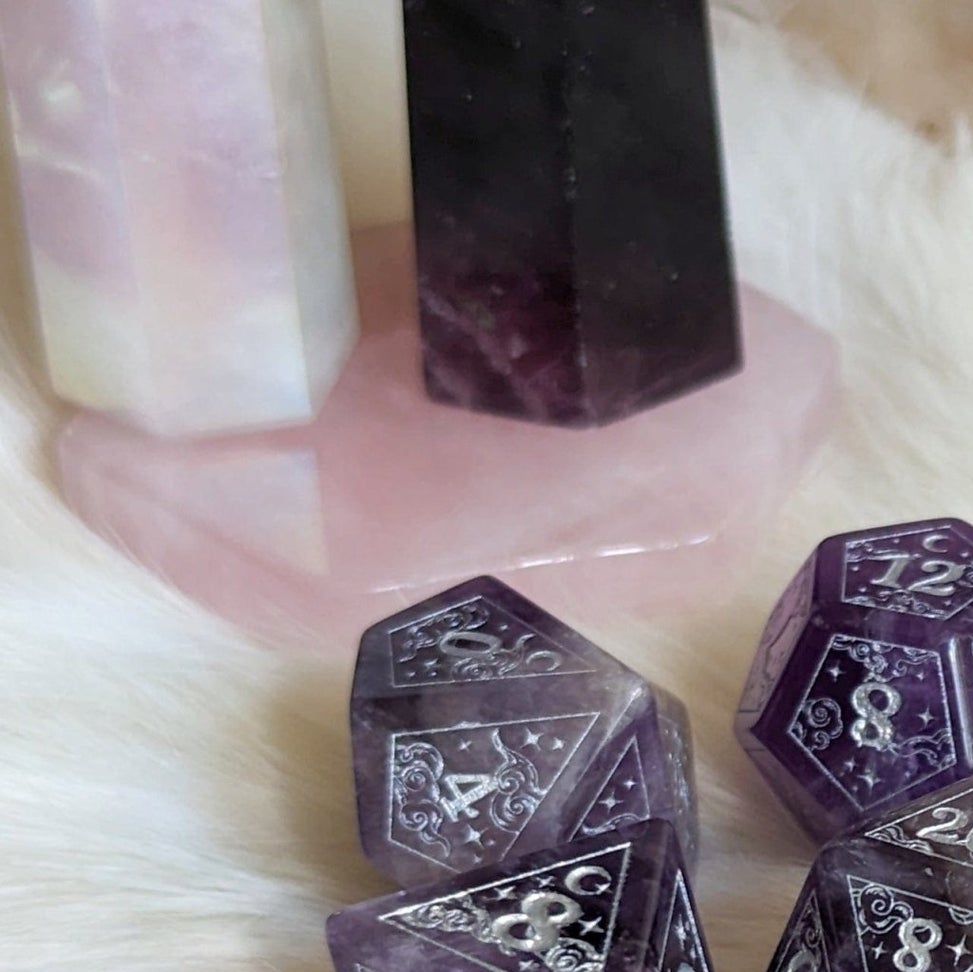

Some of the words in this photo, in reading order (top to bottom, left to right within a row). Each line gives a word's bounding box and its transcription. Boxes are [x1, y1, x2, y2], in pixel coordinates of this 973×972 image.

[871, 554, 965, 597] 12
[852, 682, 901, 751] 8
[441, 773, 499, 822] 4
[492, 891, 584, 954] 8
